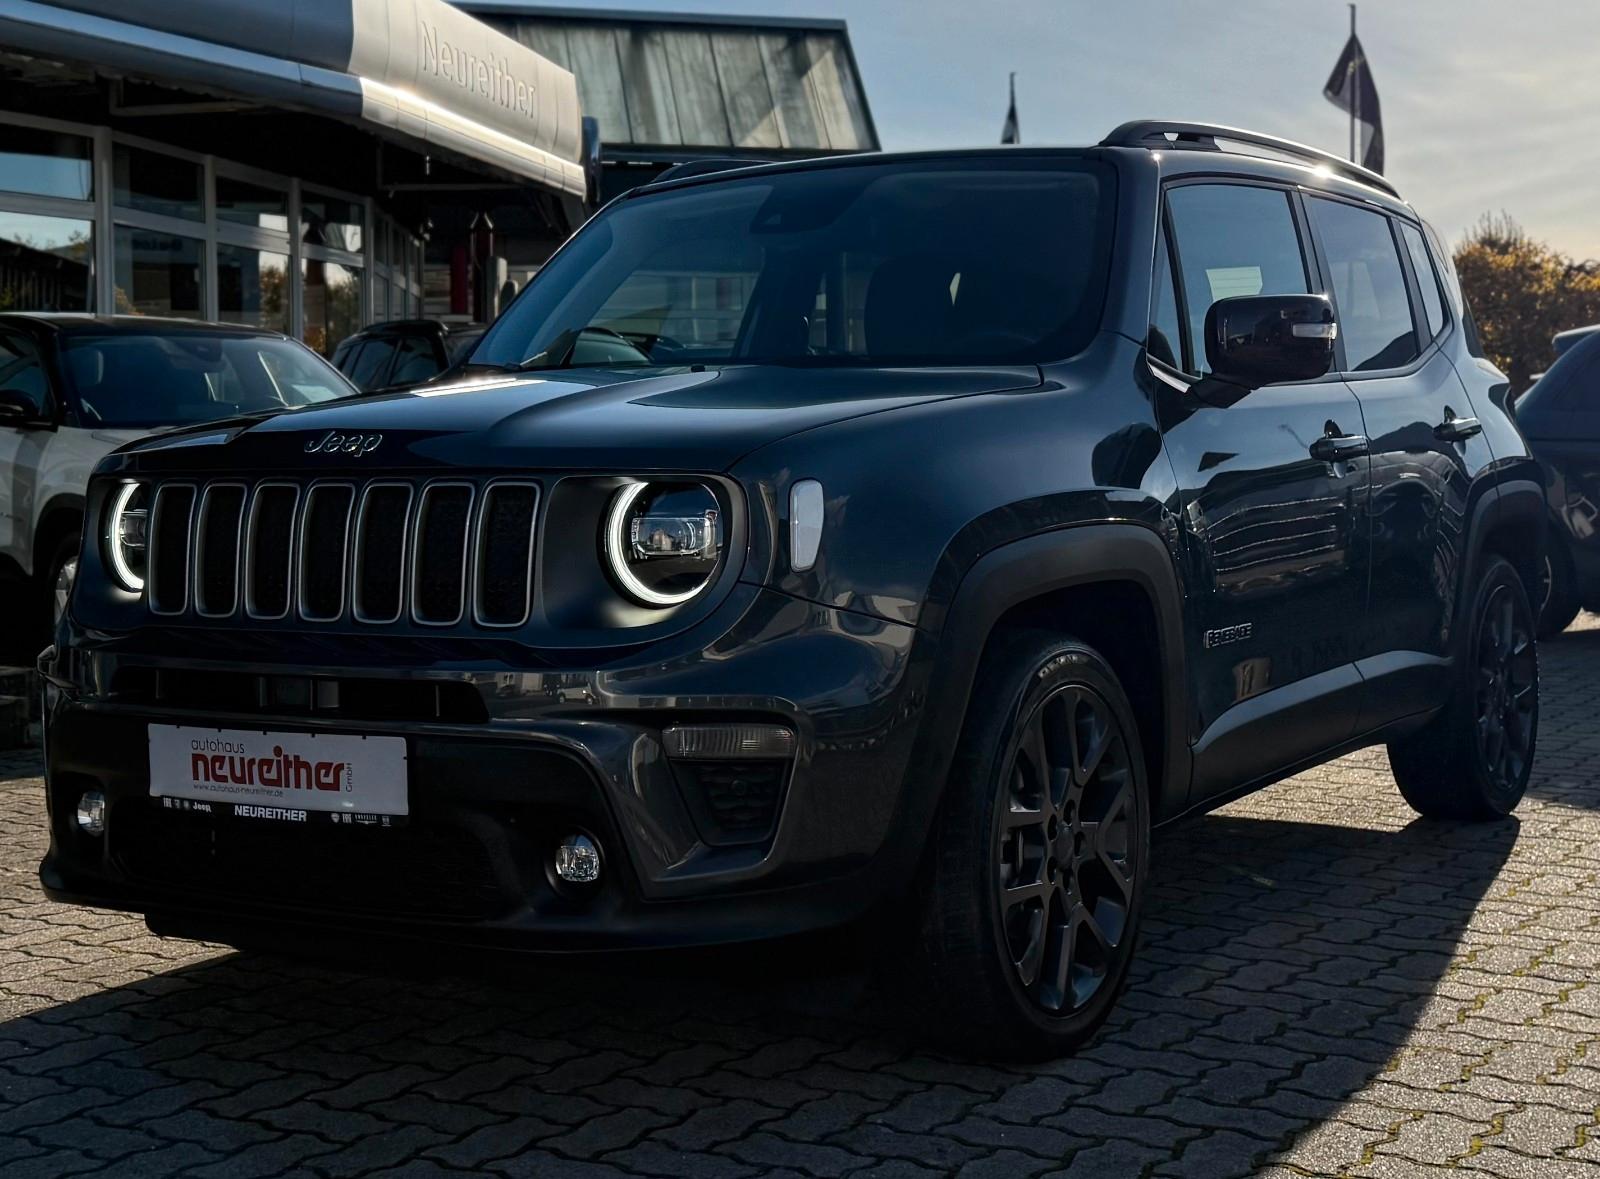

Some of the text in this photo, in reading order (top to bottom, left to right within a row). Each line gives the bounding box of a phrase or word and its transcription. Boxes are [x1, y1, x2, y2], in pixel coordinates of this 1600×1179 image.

[422, 20, 536, 119] Neureither
[303, 430, 383, 458] Jeep
[191, 738, 245, 754] autohaus
[191, 745, 353, 793] neureither GmbH
[234, 804, 307, 822] NEUREITHER
